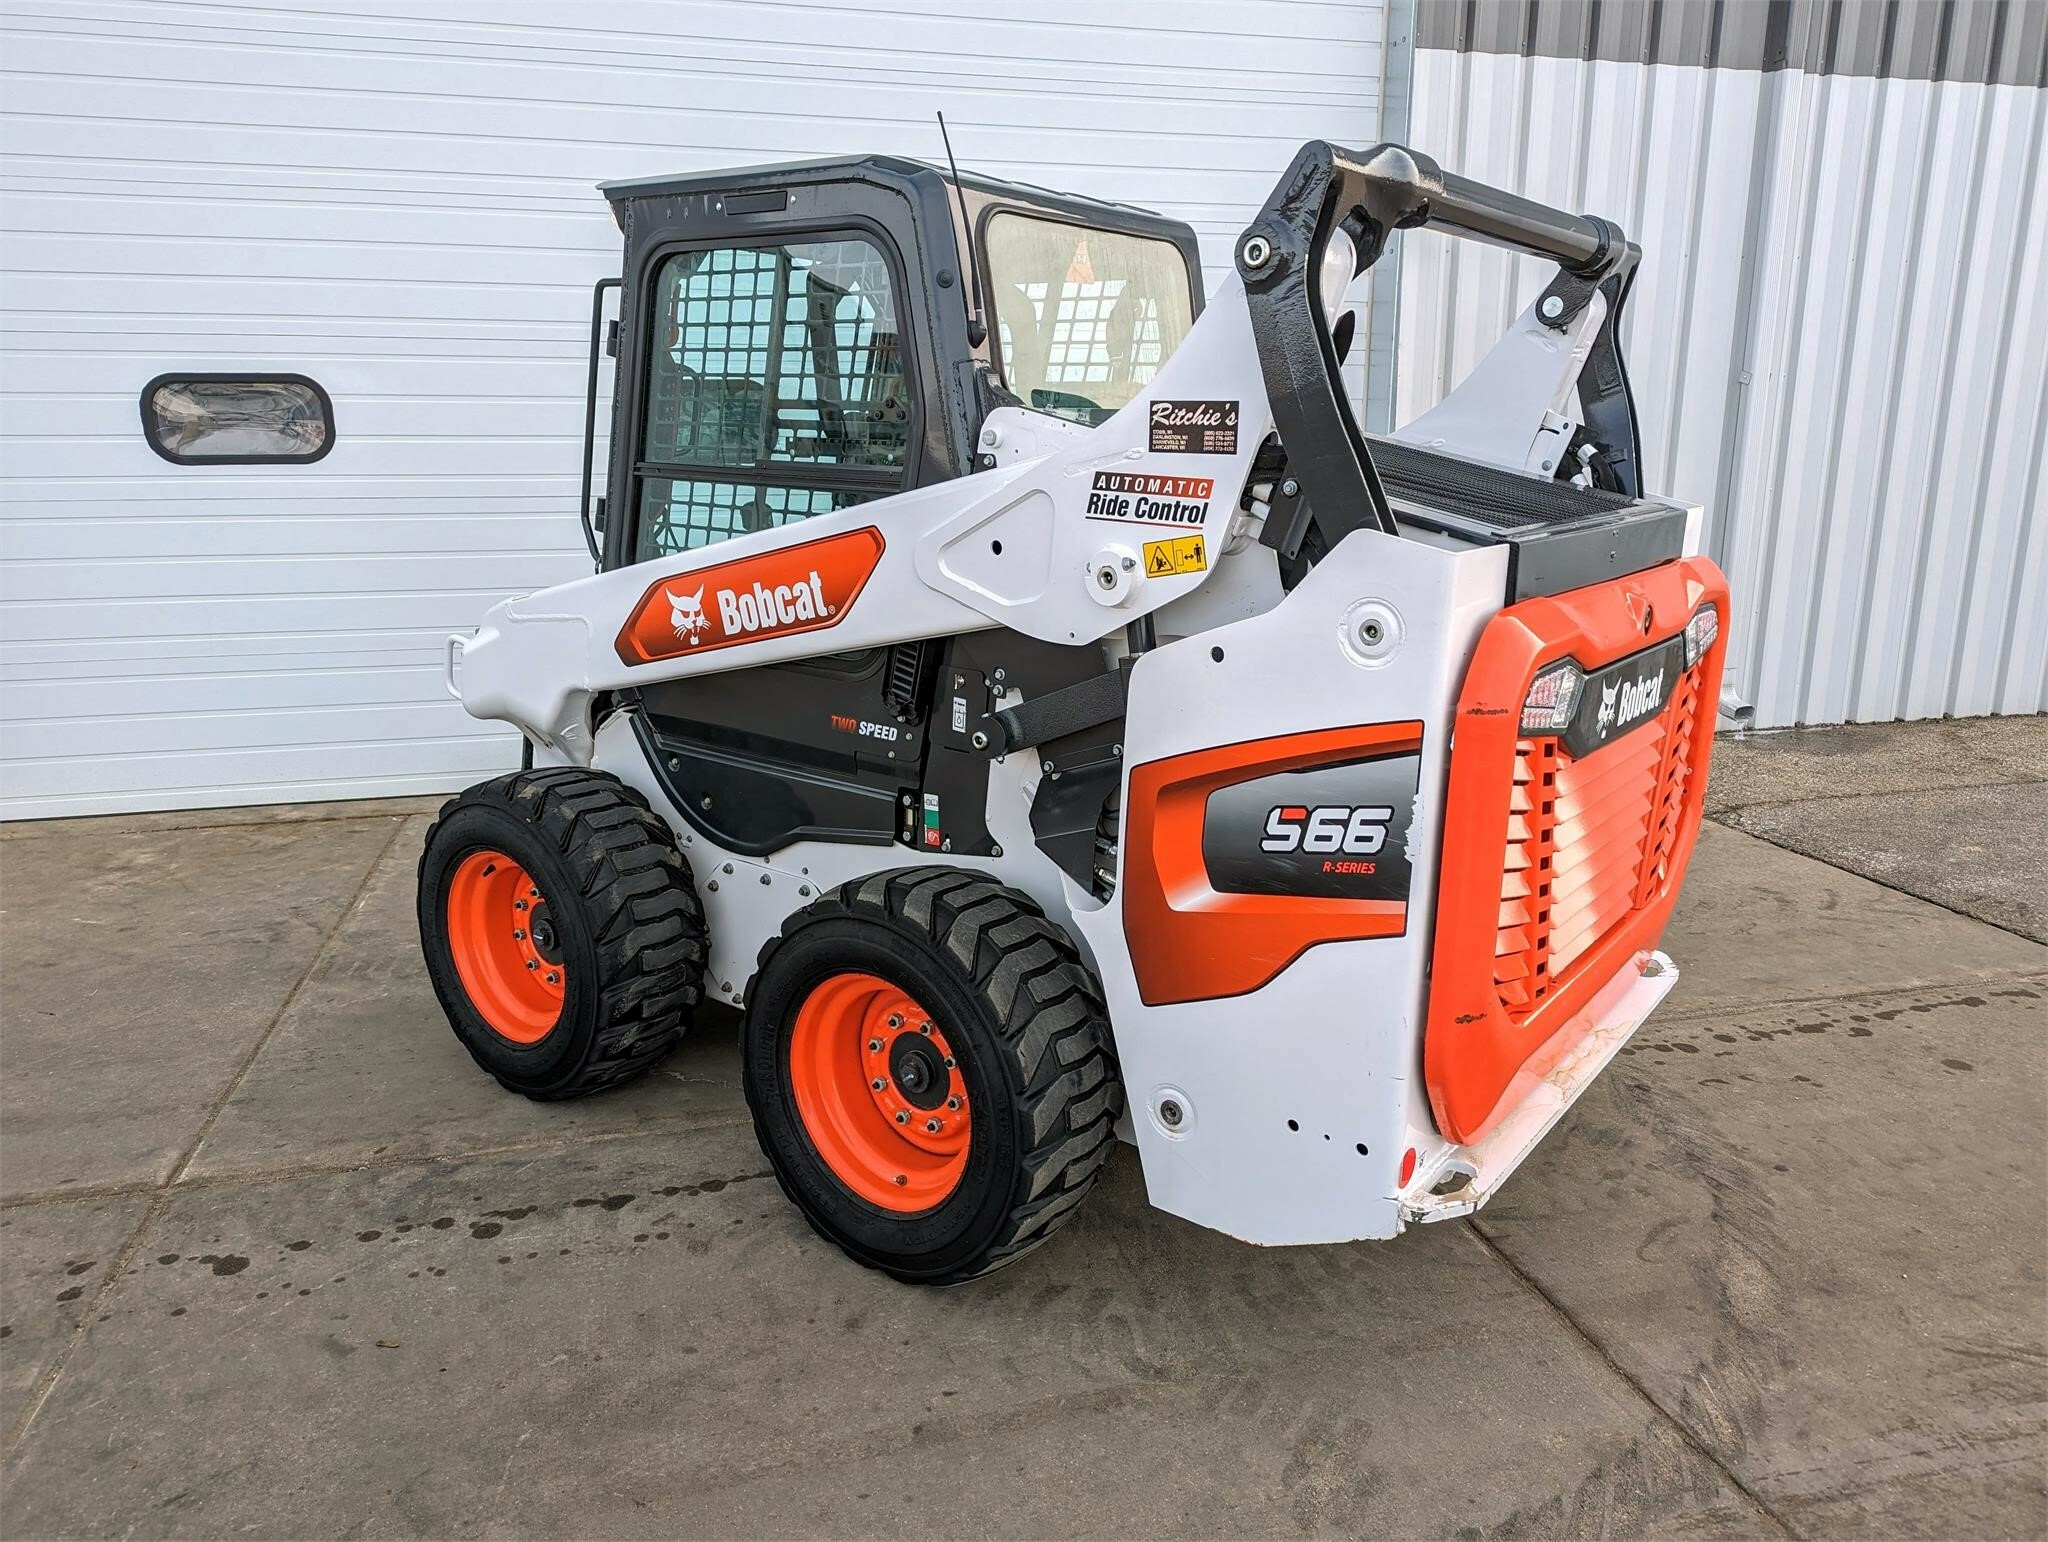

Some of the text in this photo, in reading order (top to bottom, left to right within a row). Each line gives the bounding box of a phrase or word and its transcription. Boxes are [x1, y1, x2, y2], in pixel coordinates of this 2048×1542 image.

[1151, 402, 1238, 427] Ritchie's
[1096, 474, 1209, 497] AUTOMATIC
[1086, 492, 1209, 524] Ride Control
[716, 570, 829, 636] Bobcat
[1617, 667, 1665, 727] Bobcat
[831, 715, 898, 742] TWO SPEED
[1260, 805, 1395, 856] S66
[1322, 860, 1376, 875] R-SERIES
